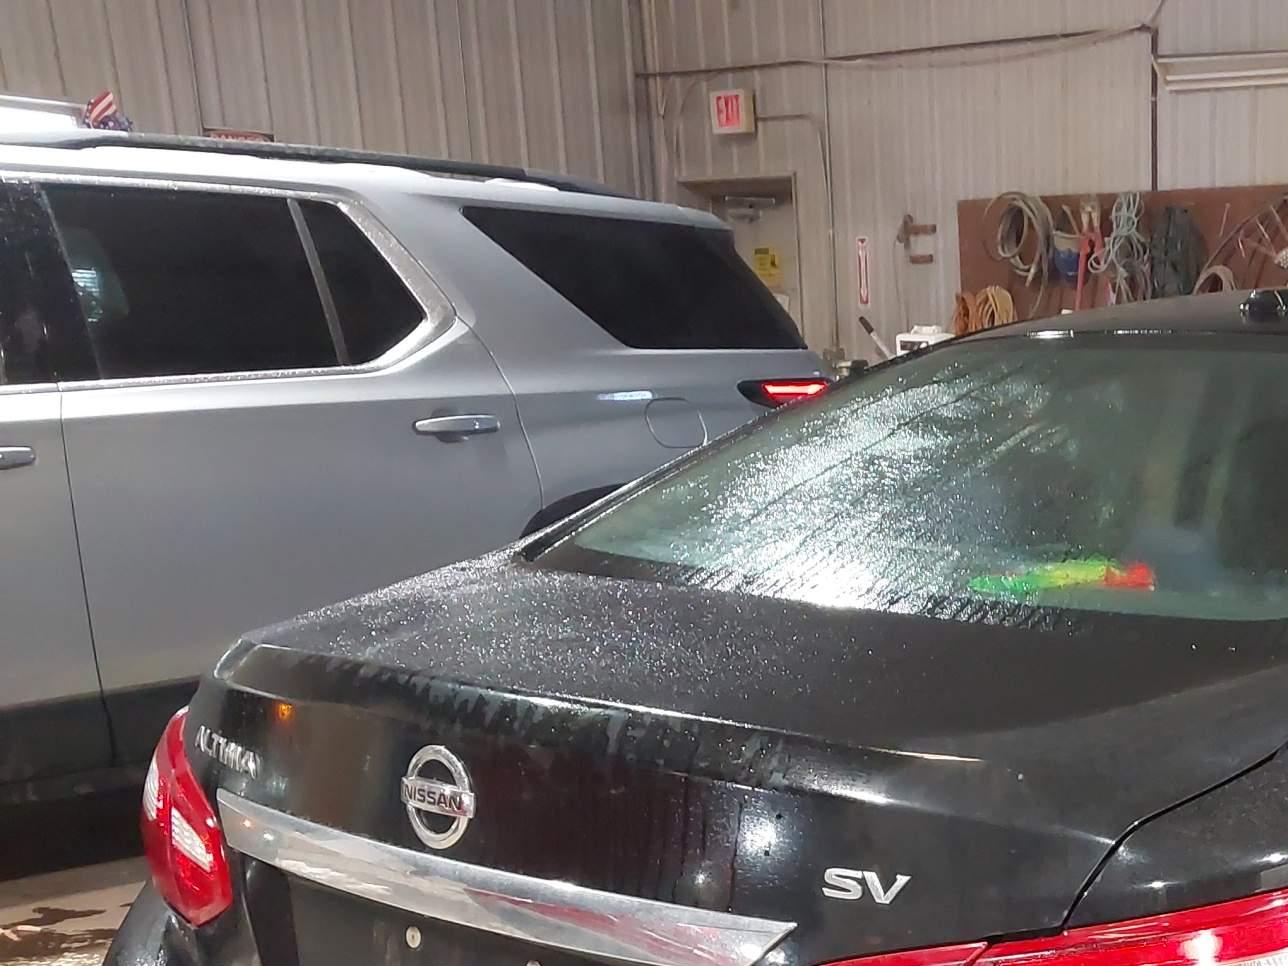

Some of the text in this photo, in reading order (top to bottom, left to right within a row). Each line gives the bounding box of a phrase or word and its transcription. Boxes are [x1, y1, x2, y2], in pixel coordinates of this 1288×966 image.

[715, 95, 740, 127] EXIT
[194, 725, 261, 780] ALTIMA
[403, 783, 463, 812] NISSAN
[821, 867, 912, 904] SV
